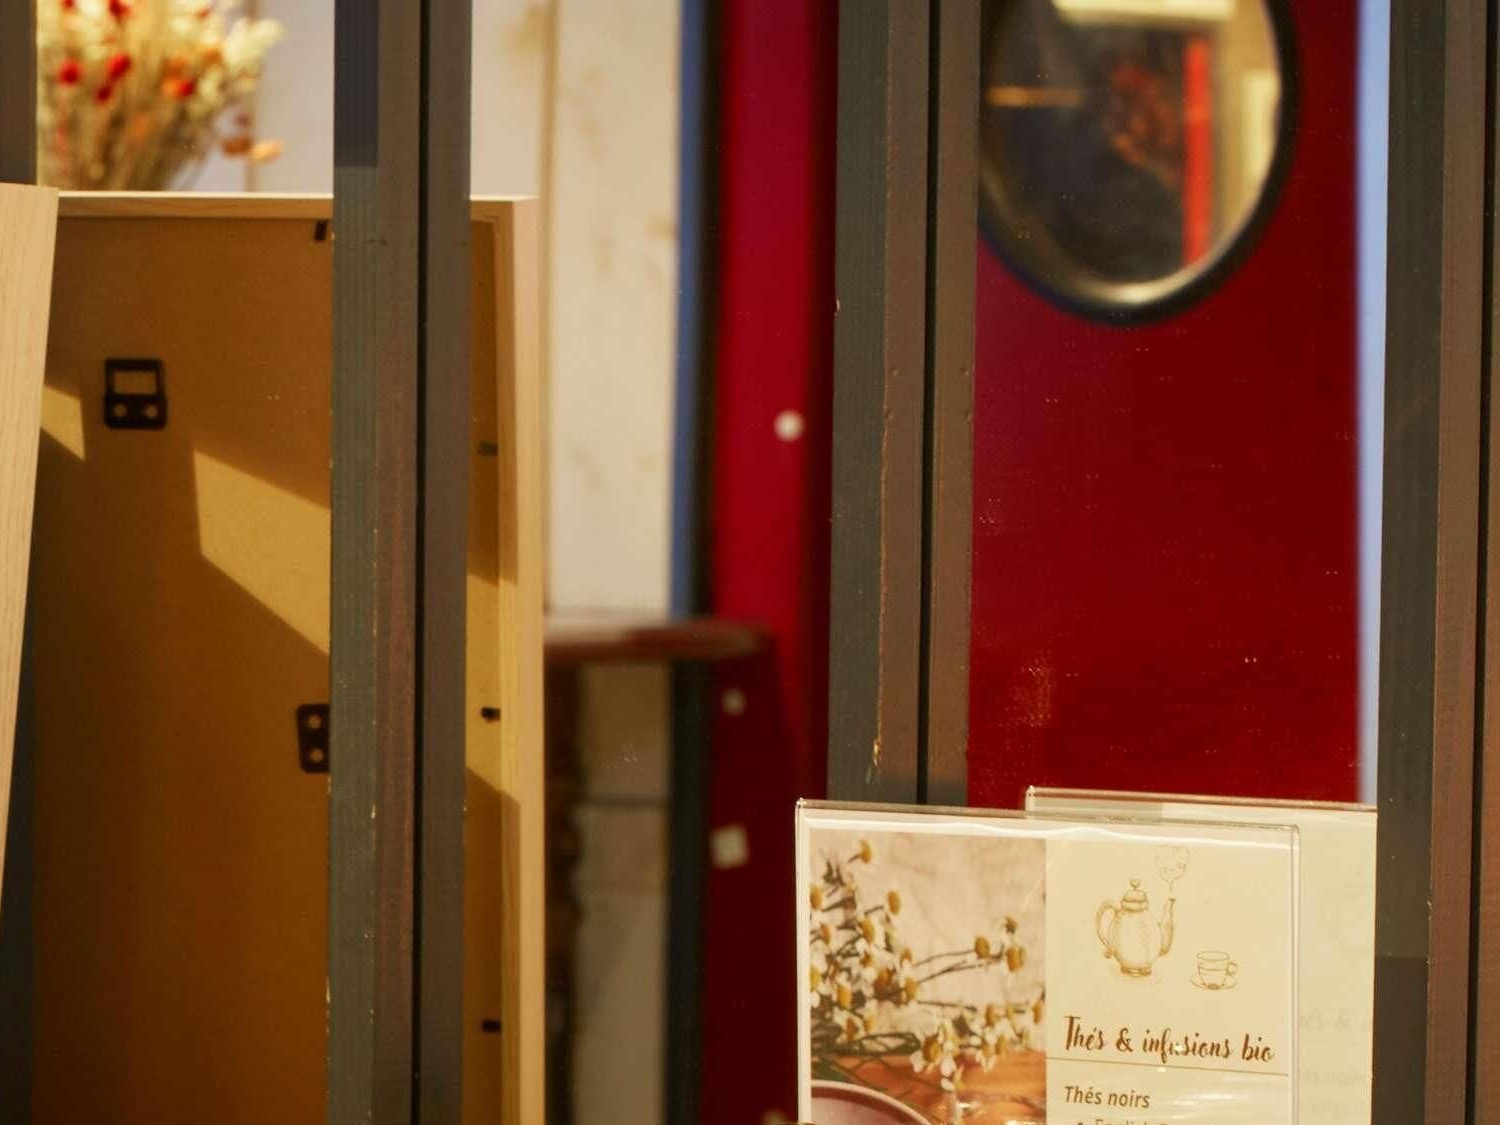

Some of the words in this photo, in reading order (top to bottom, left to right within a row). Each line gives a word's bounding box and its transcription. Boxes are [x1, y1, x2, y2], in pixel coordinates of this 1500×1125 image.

[1063, 1016, 1105, 1050] Thés
[1115, 1028, 1134, 1052] &
[1142, 1028, 1232, 1064] infusions
[1241, 1033, 1275, 1062] bio
[1064, 1086, 1102, 1106] Thés
[1107, 1088, 1150, 1109] noirs
